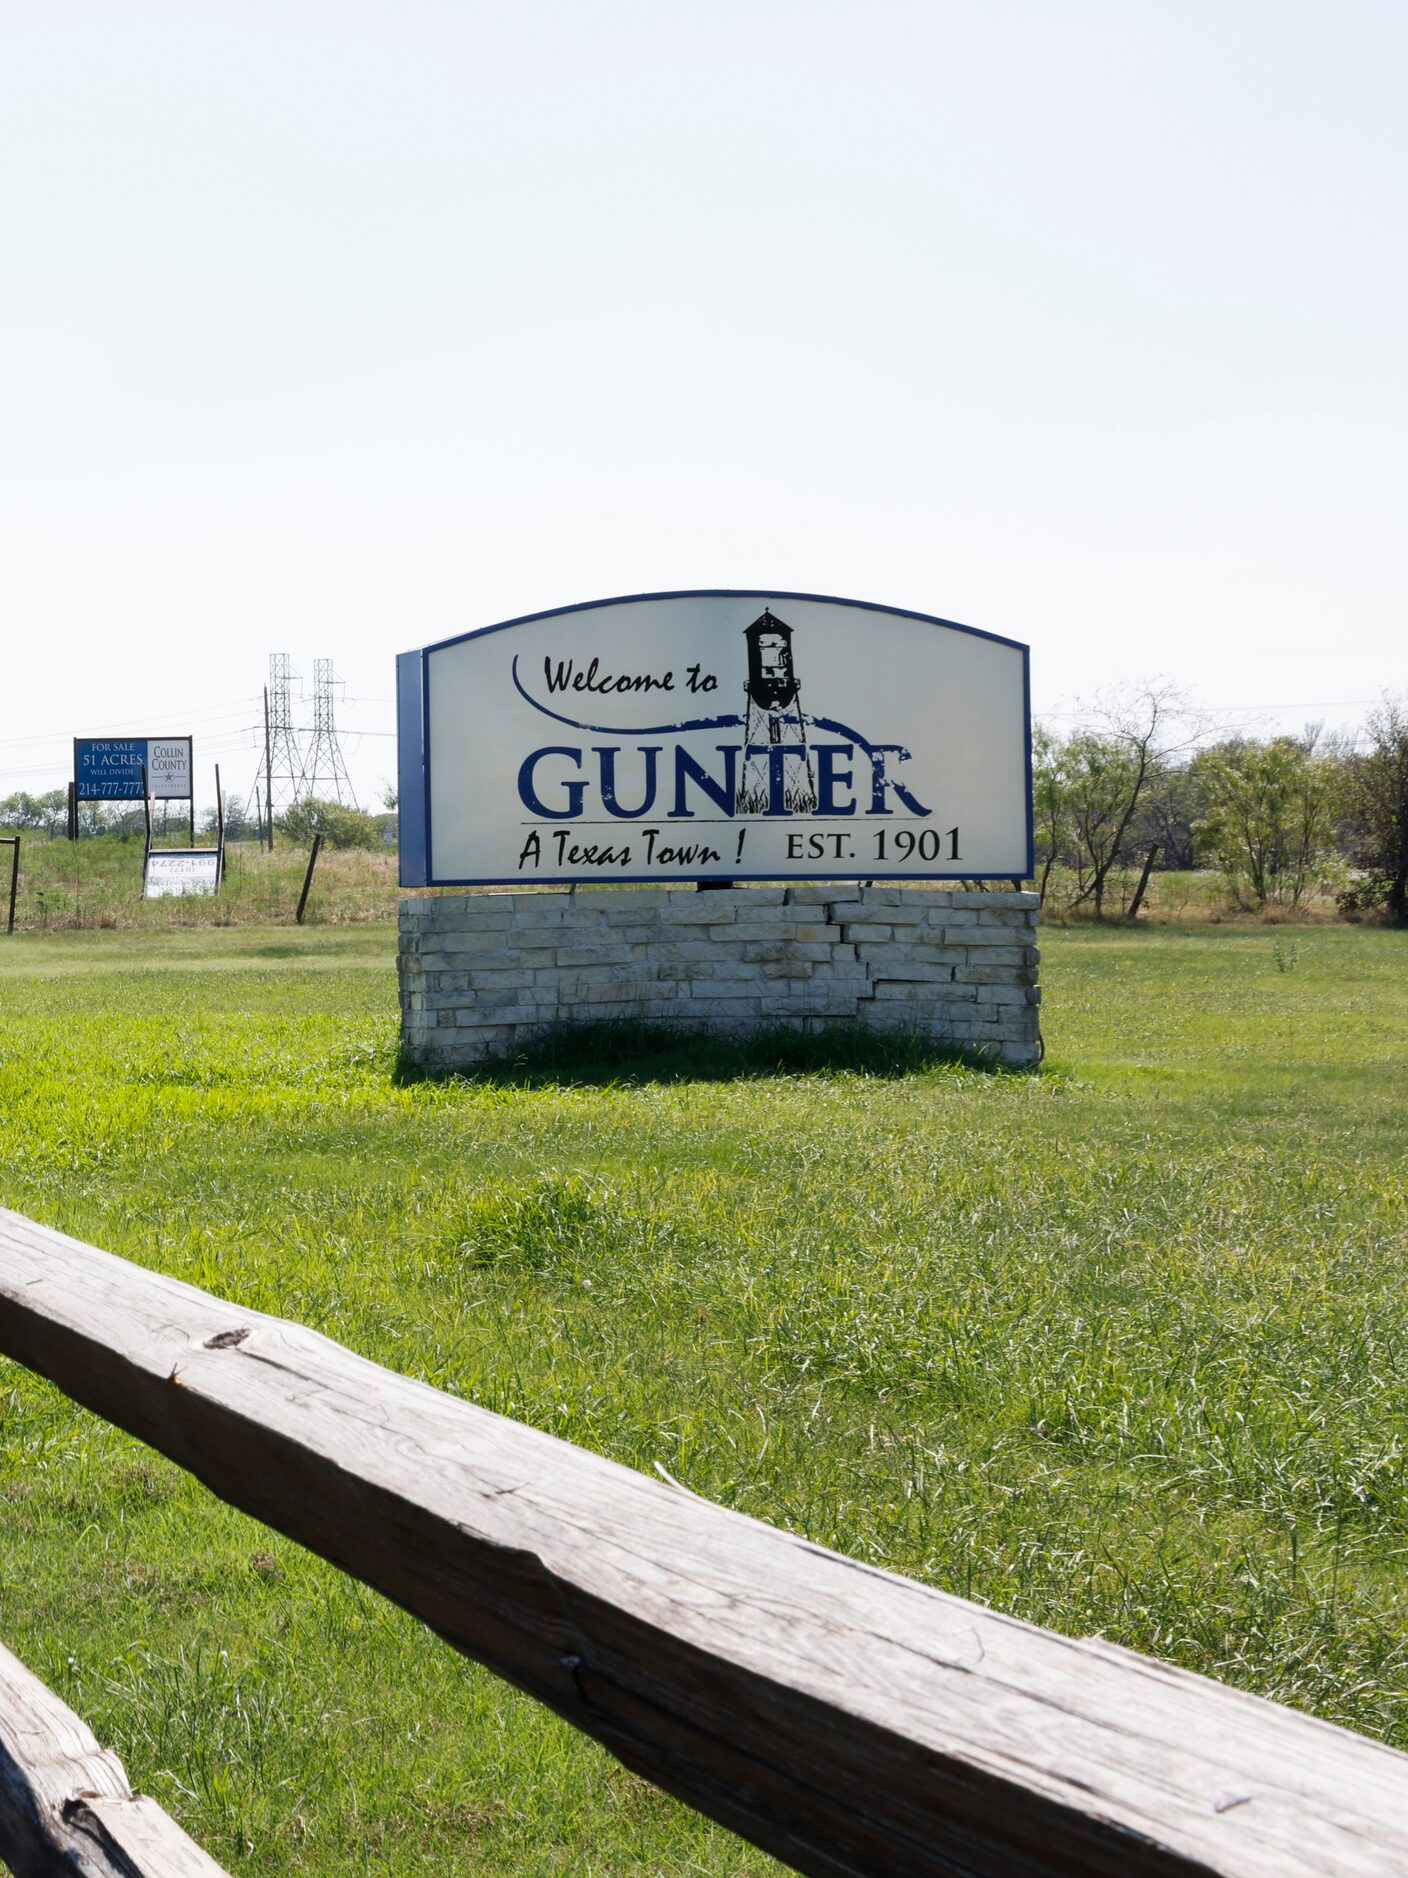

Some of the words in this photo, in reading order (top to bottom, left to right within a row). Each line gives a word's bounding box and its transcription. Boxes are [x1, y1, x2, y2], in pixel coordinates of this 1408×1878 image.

[544, 656, 675, 694] Welcome
[685, 663, 719, 693] to
[92, 743, 111, 751] FOR
[113, 743, 135, 751] SALE
[153, 746, 184, 758] COLLIN
[83, 755, 96, 766] 51
[101, 754, 143, 766] ACRES
[152, 759, 187, 771] COUNTY
[517, 743, 933, 819] GUNTER
[518, 830, 541, 870] A
[553, 830, 632, 866] Texas
[644, 829, 721, 866] Town
[785, 833, 856, 860] EST.
[873, 827, 963, 862] 1901
